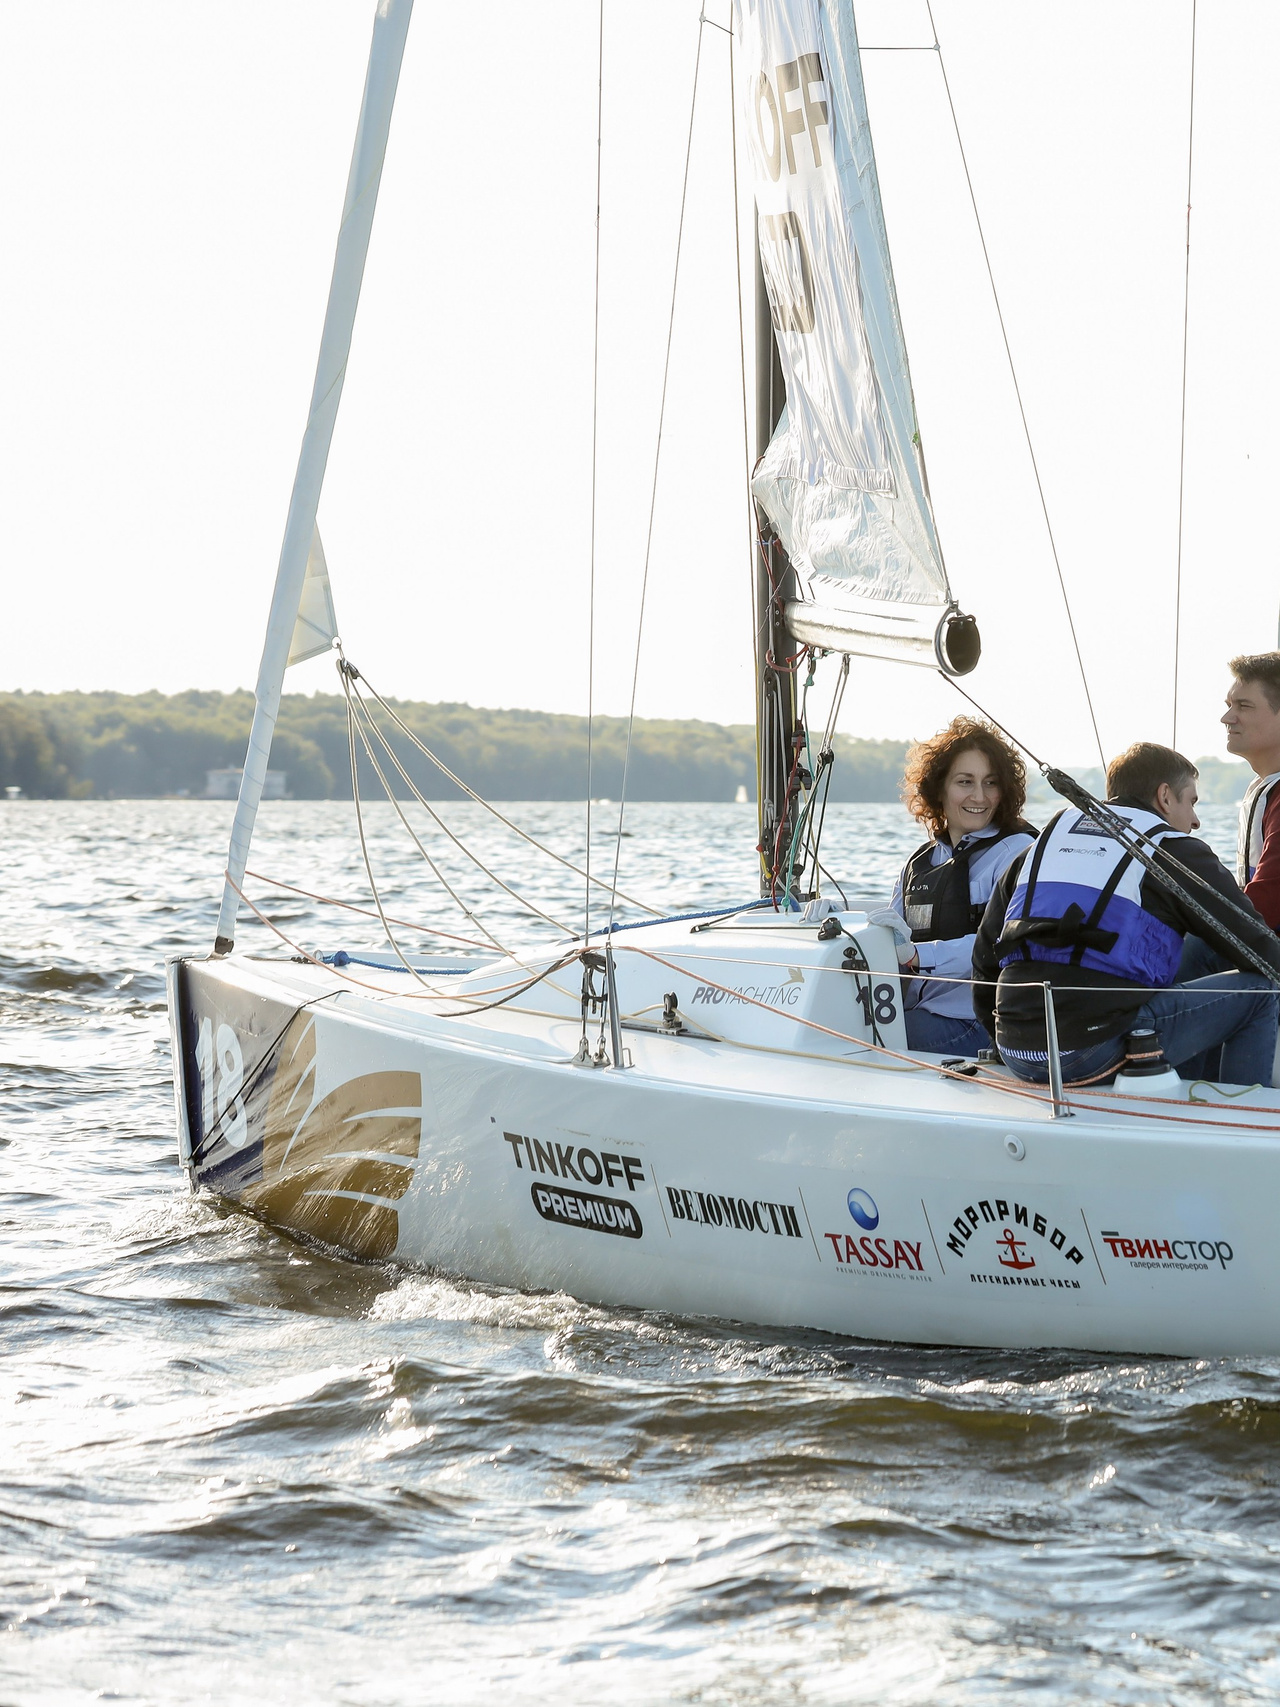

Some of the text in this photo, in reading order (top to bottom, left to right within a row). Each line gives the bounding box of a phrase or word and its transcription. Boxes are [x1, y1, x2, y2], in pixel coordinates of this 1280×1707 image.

[691, 986, 802, 1005] PROYACHTING
[855, 983, 897, 1026] 18
[195, 1016, 248, 1149] 18
[503, 1131, 646, 1192] TINKOFF
[535, 1190, 637, 1233] PREMIUM
[665, 1186, 804, 1239] ВЕДОМОСТИ
[946, 1199, 1085, 1265] МОРПРИБОР
[824, 1233, 925, 1272] TASSAY
[836, 1266, 868, 1276] PREMIUM
[871, 1270, 907, 1280] DRINKING
[1130, 1261, 1209, 1271] галерея интерьеров
[970, 1274, 1081, 1289] ЛЕГЕНДАРНЫЕ ЧАСЫ
